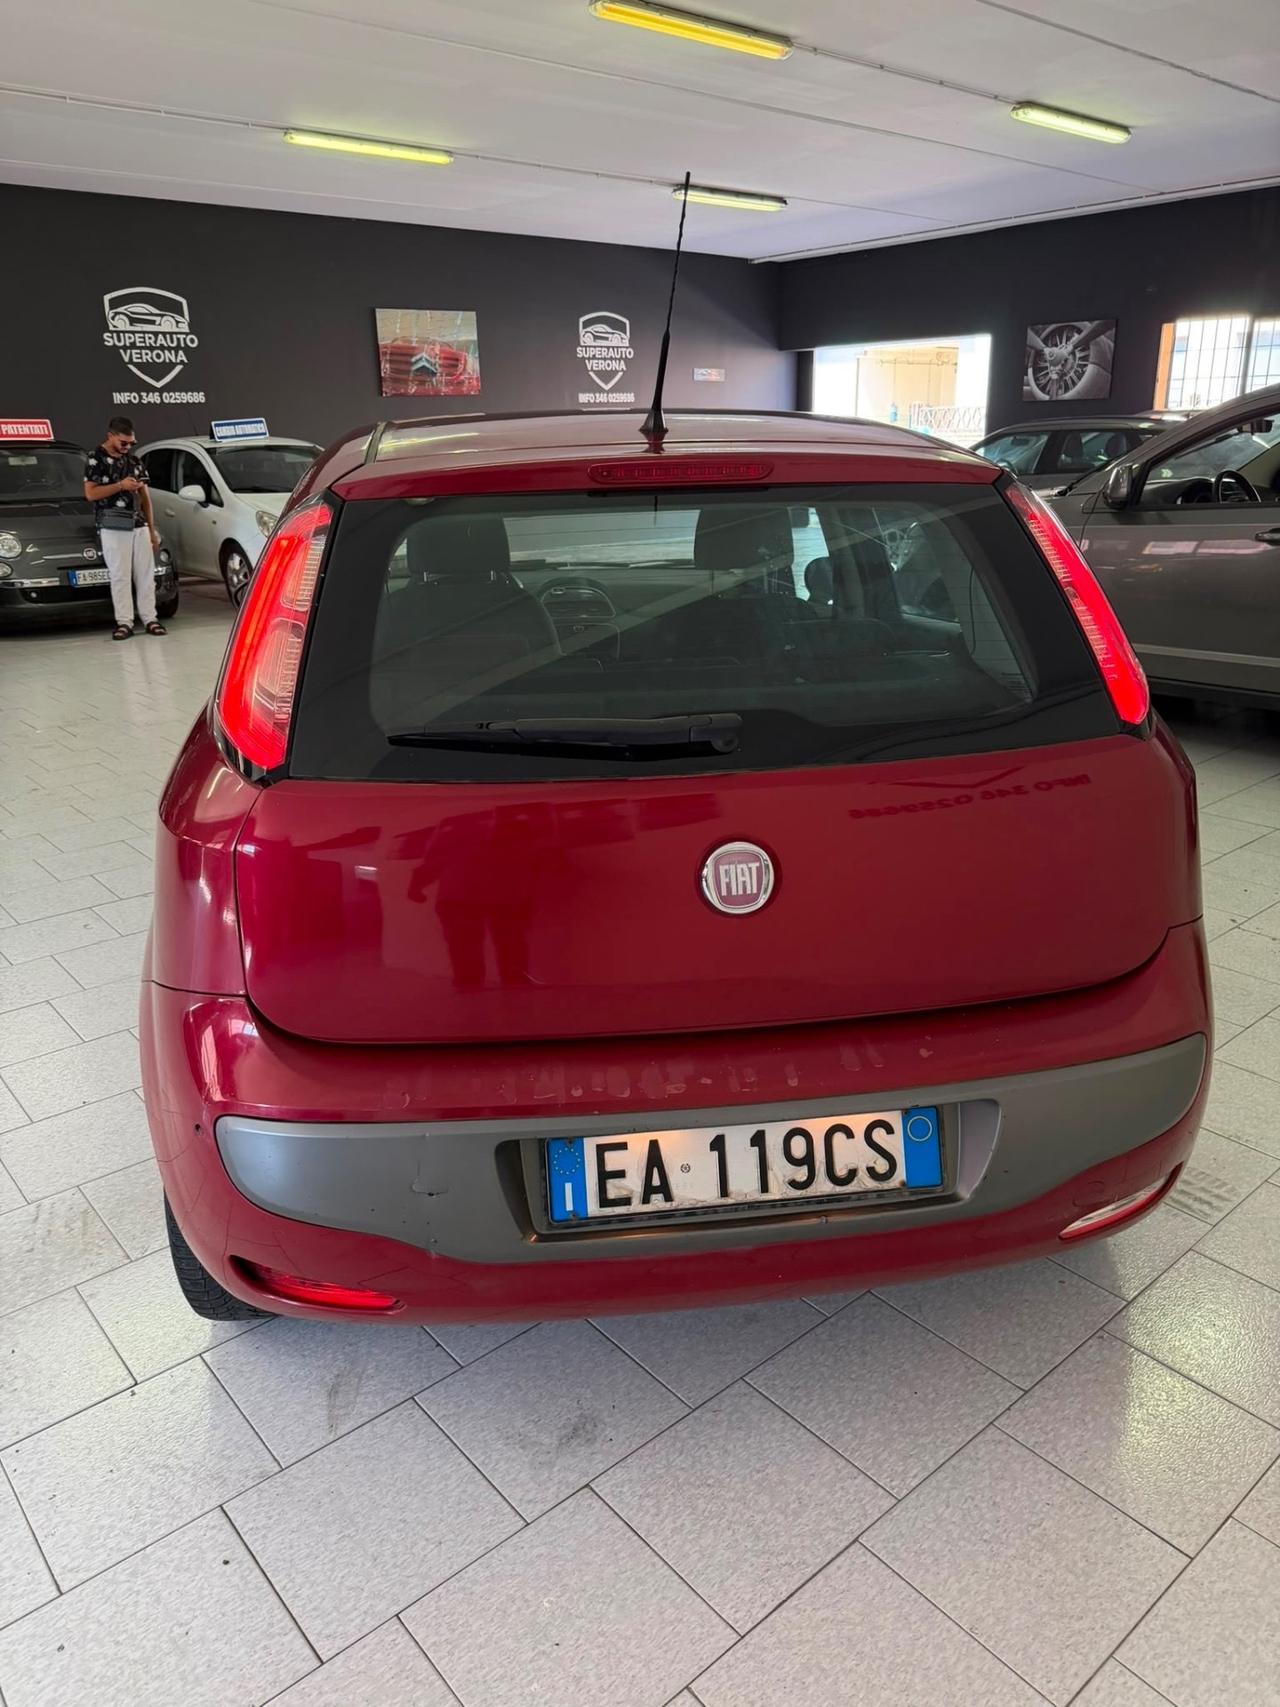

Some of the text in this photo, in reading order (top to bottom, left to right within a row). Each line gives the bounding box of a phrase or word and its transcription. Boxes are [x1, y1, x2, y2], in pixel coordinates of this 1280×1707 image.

[103, 333, 199, 348] SUPERAUTO
[119, 349, 188, 363] VERONA
[576, 347, 634, 359] SUPERAUTO
[585, 359, 627, 371] VERONA
[112, 391, 206, 404] INFO 346 0259686
[578, 392, 594, 403] INFO
[719, 862, 760, 896] FIAT
[596, 1118, 898, 1208] EA 119CS
